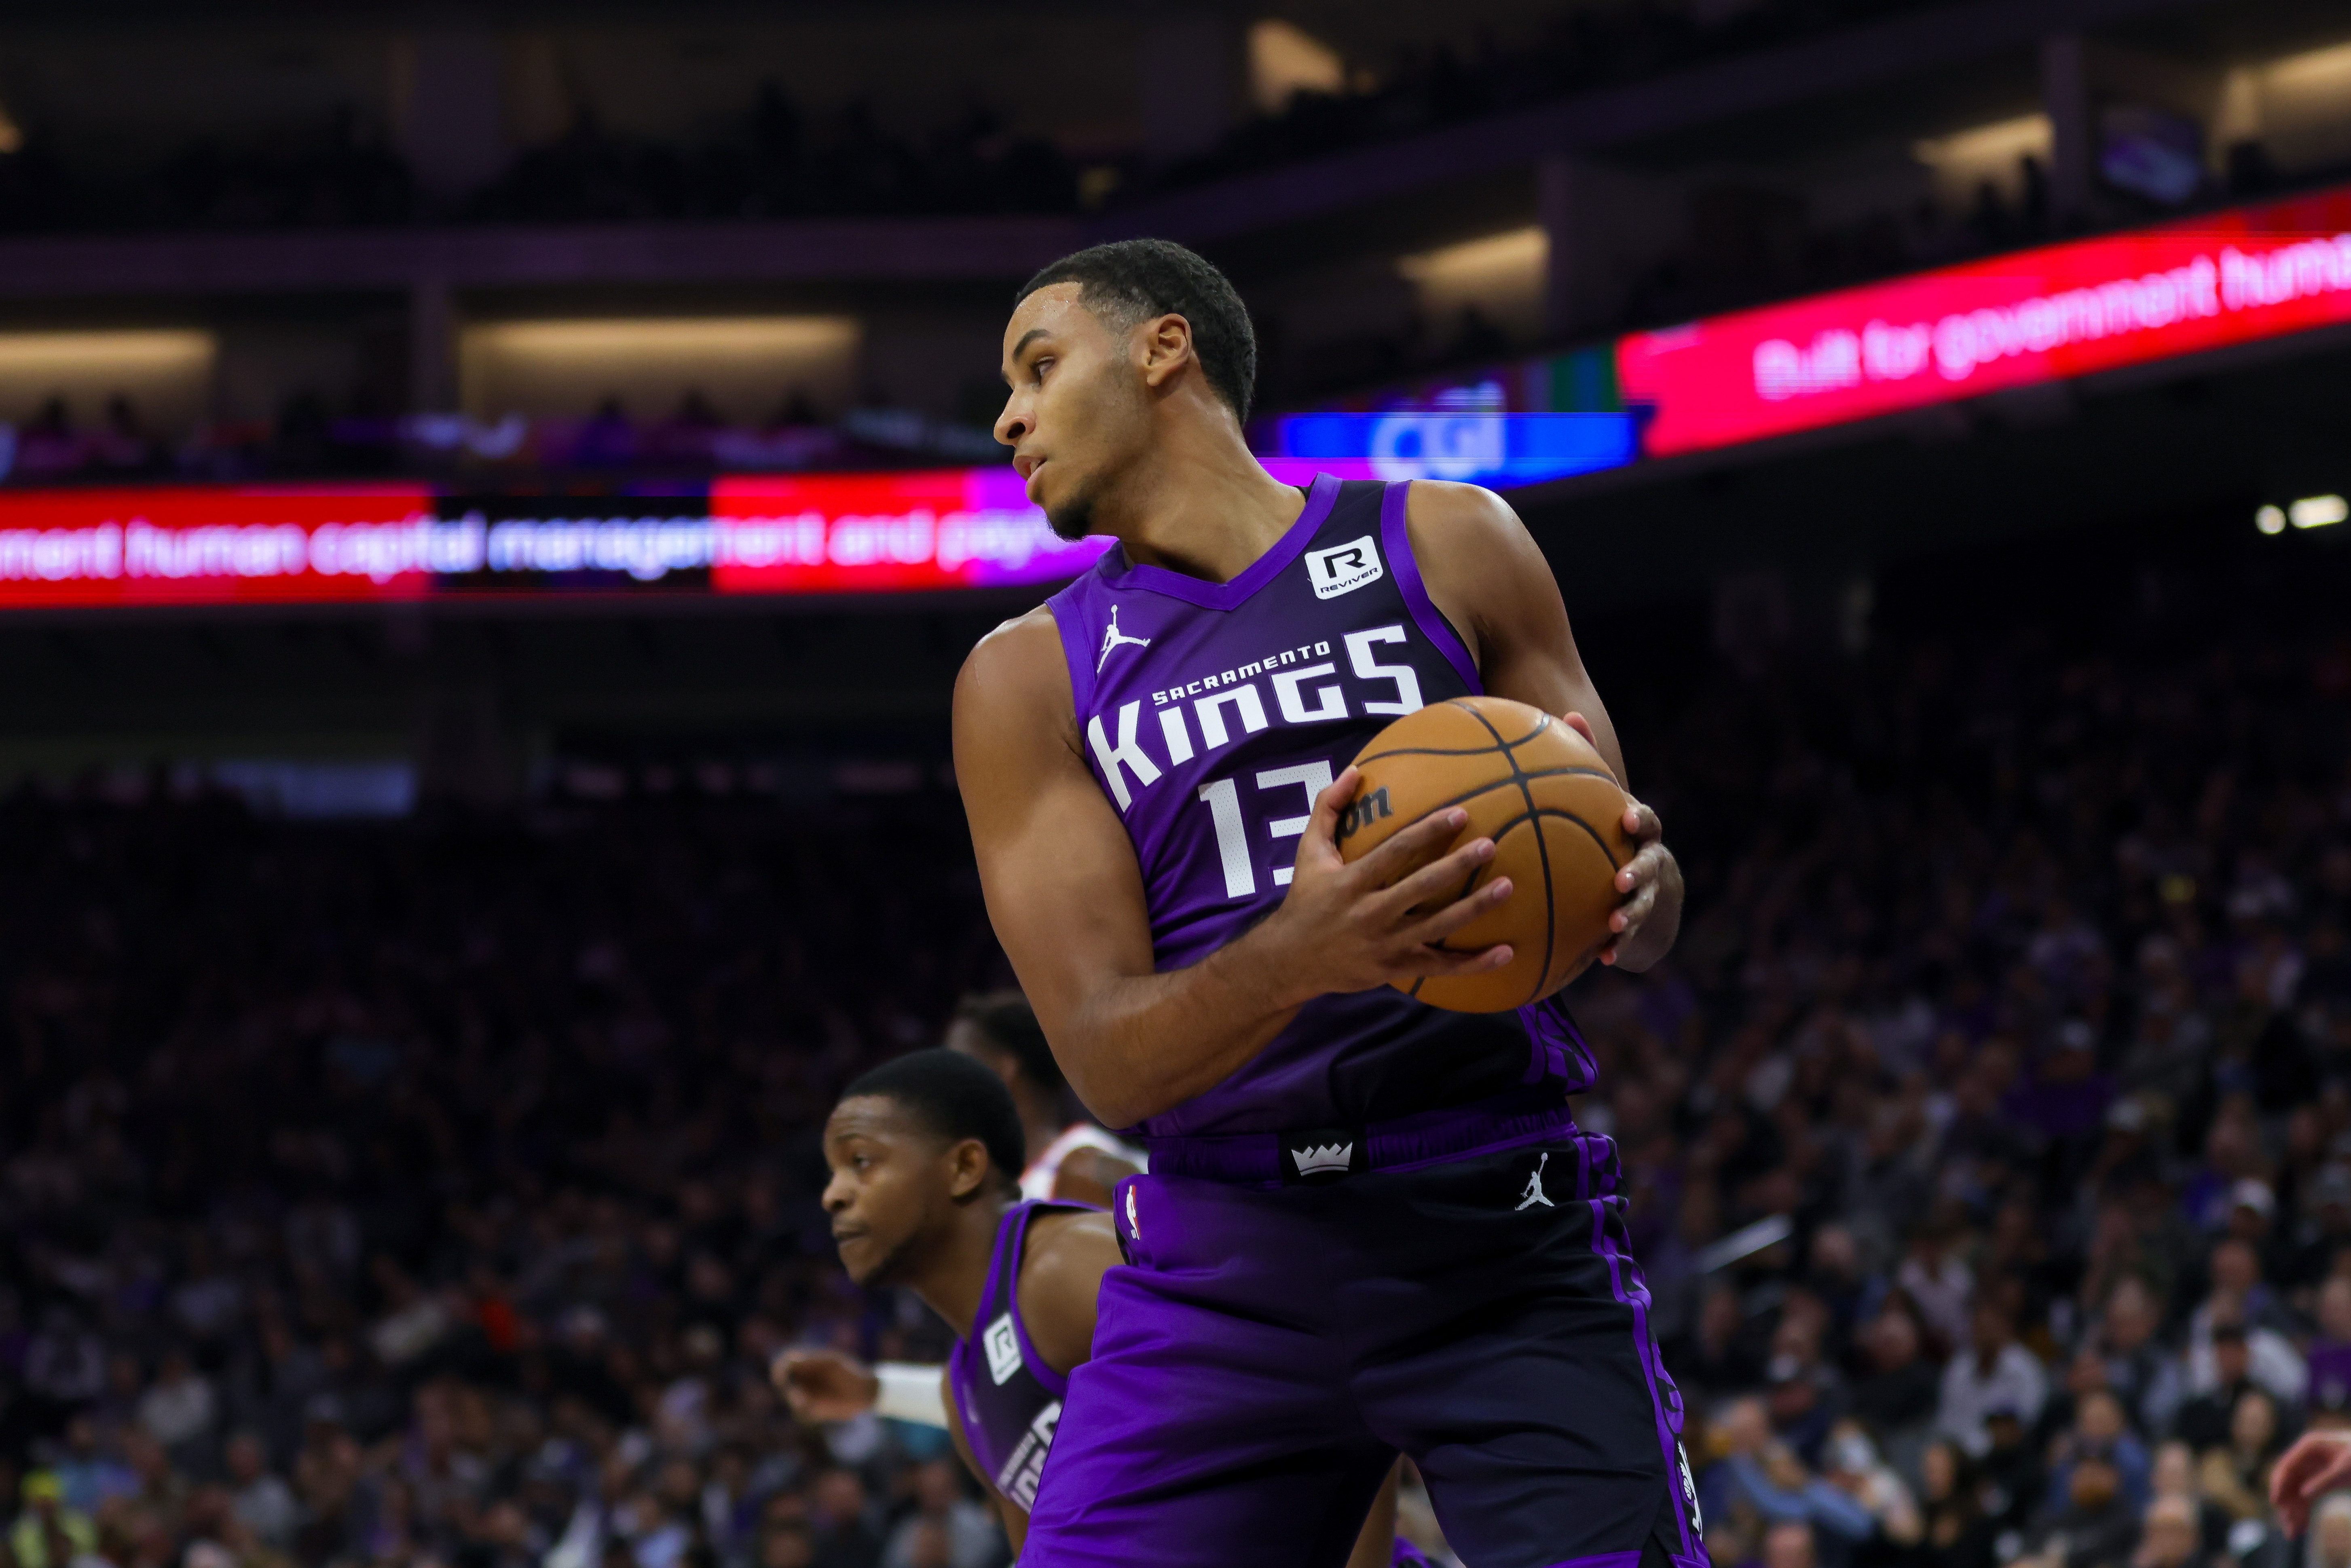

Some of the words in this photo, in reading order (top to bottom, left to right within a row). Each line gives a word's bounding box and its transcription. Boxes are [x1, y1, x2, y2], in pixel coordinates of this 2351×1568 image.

[1862, 319, 1929, 381] for
[1932, 254, 2218, 381] government
[125, 516, 308, 578] human
[309, 510, 486, 584] capital
[488, 509, 826, 580] management
[827, 509, 935, 566] and
[1320, 567, 1378, 593] REVIVER
[1323, 548, 1366, 579] R
[1152, 641, 1331, 706] SACRAMENTO
[1198, 760, 1334, 898] 13
